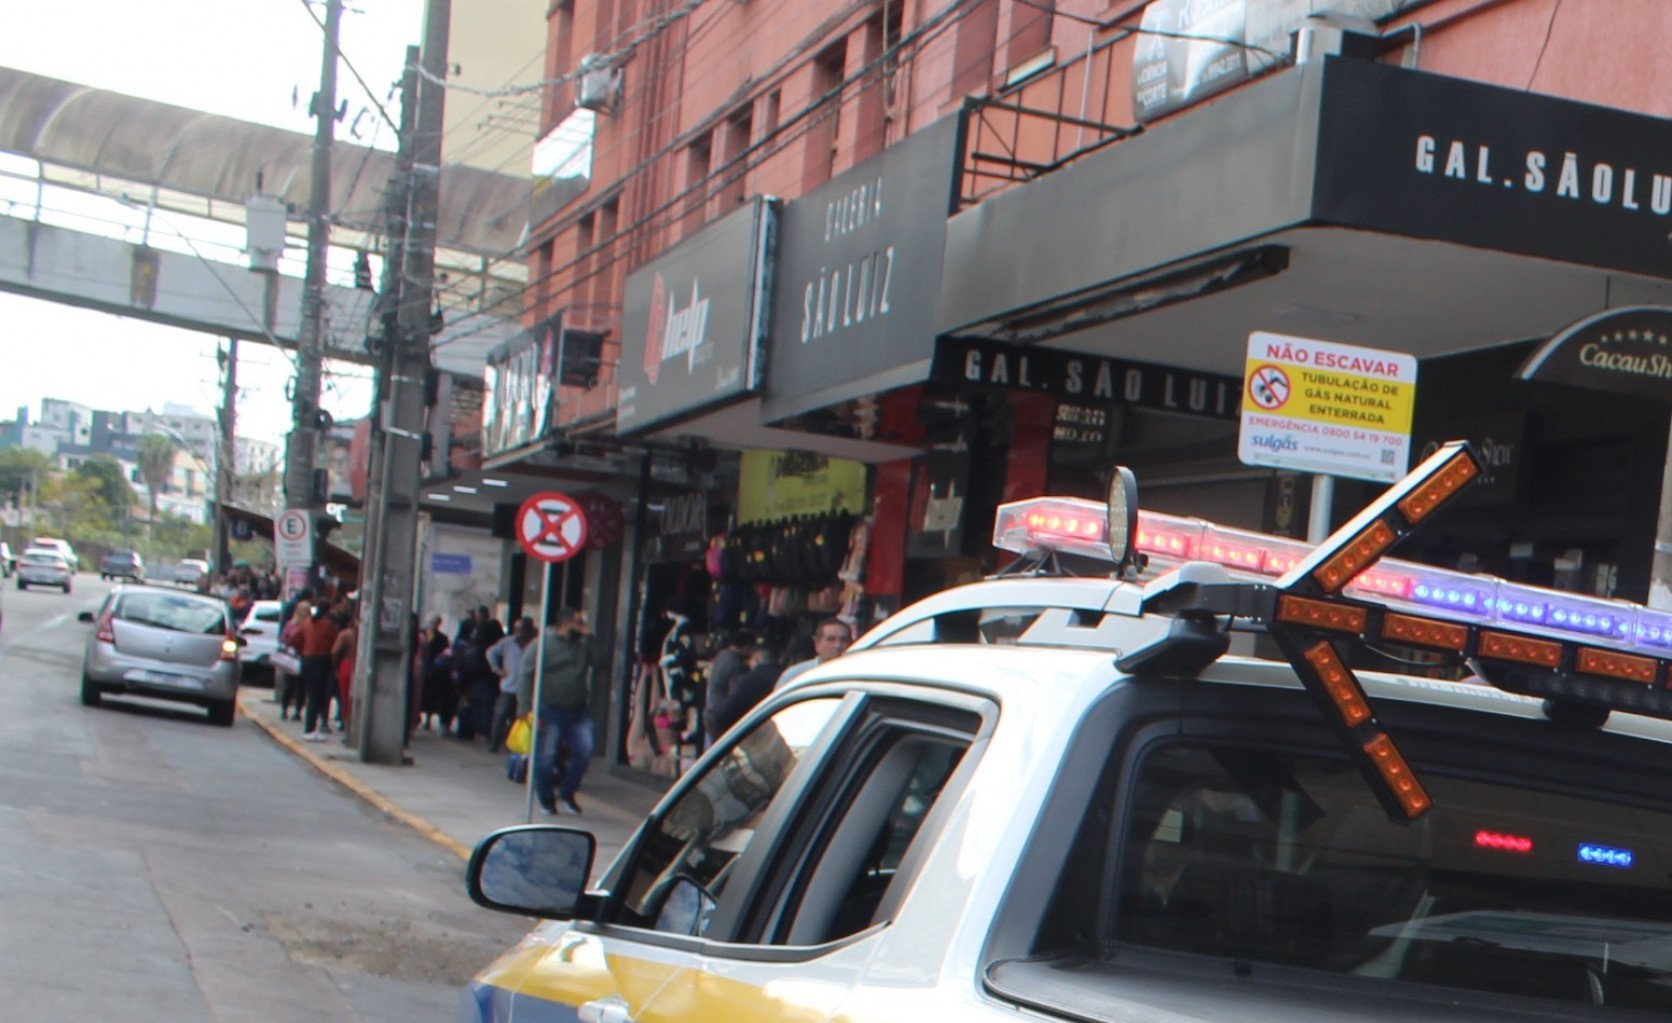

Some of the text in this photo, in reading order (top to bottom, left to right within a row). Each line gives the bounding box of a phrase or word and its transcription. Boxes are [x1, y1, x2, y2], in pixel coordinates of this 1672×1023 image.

[824, 175, 883, 242] GALERIA
[1266, 342, 1399, 377] NÃO ESCAVAR
[1065, 359, 1142, 402] SÃO
[1301, 372, 1399, 396] TUBULAÇÃO DE
[1304, 388, 1392, 410] GÁS NATURAL
[1308, 404, 1385, 424] ENTERRADA
[1248, 416, 1320, 434] EMERGÊNCIA
[1322, 427, 1350, 439] 0800
[1382, 435, 1403, 446] 700
